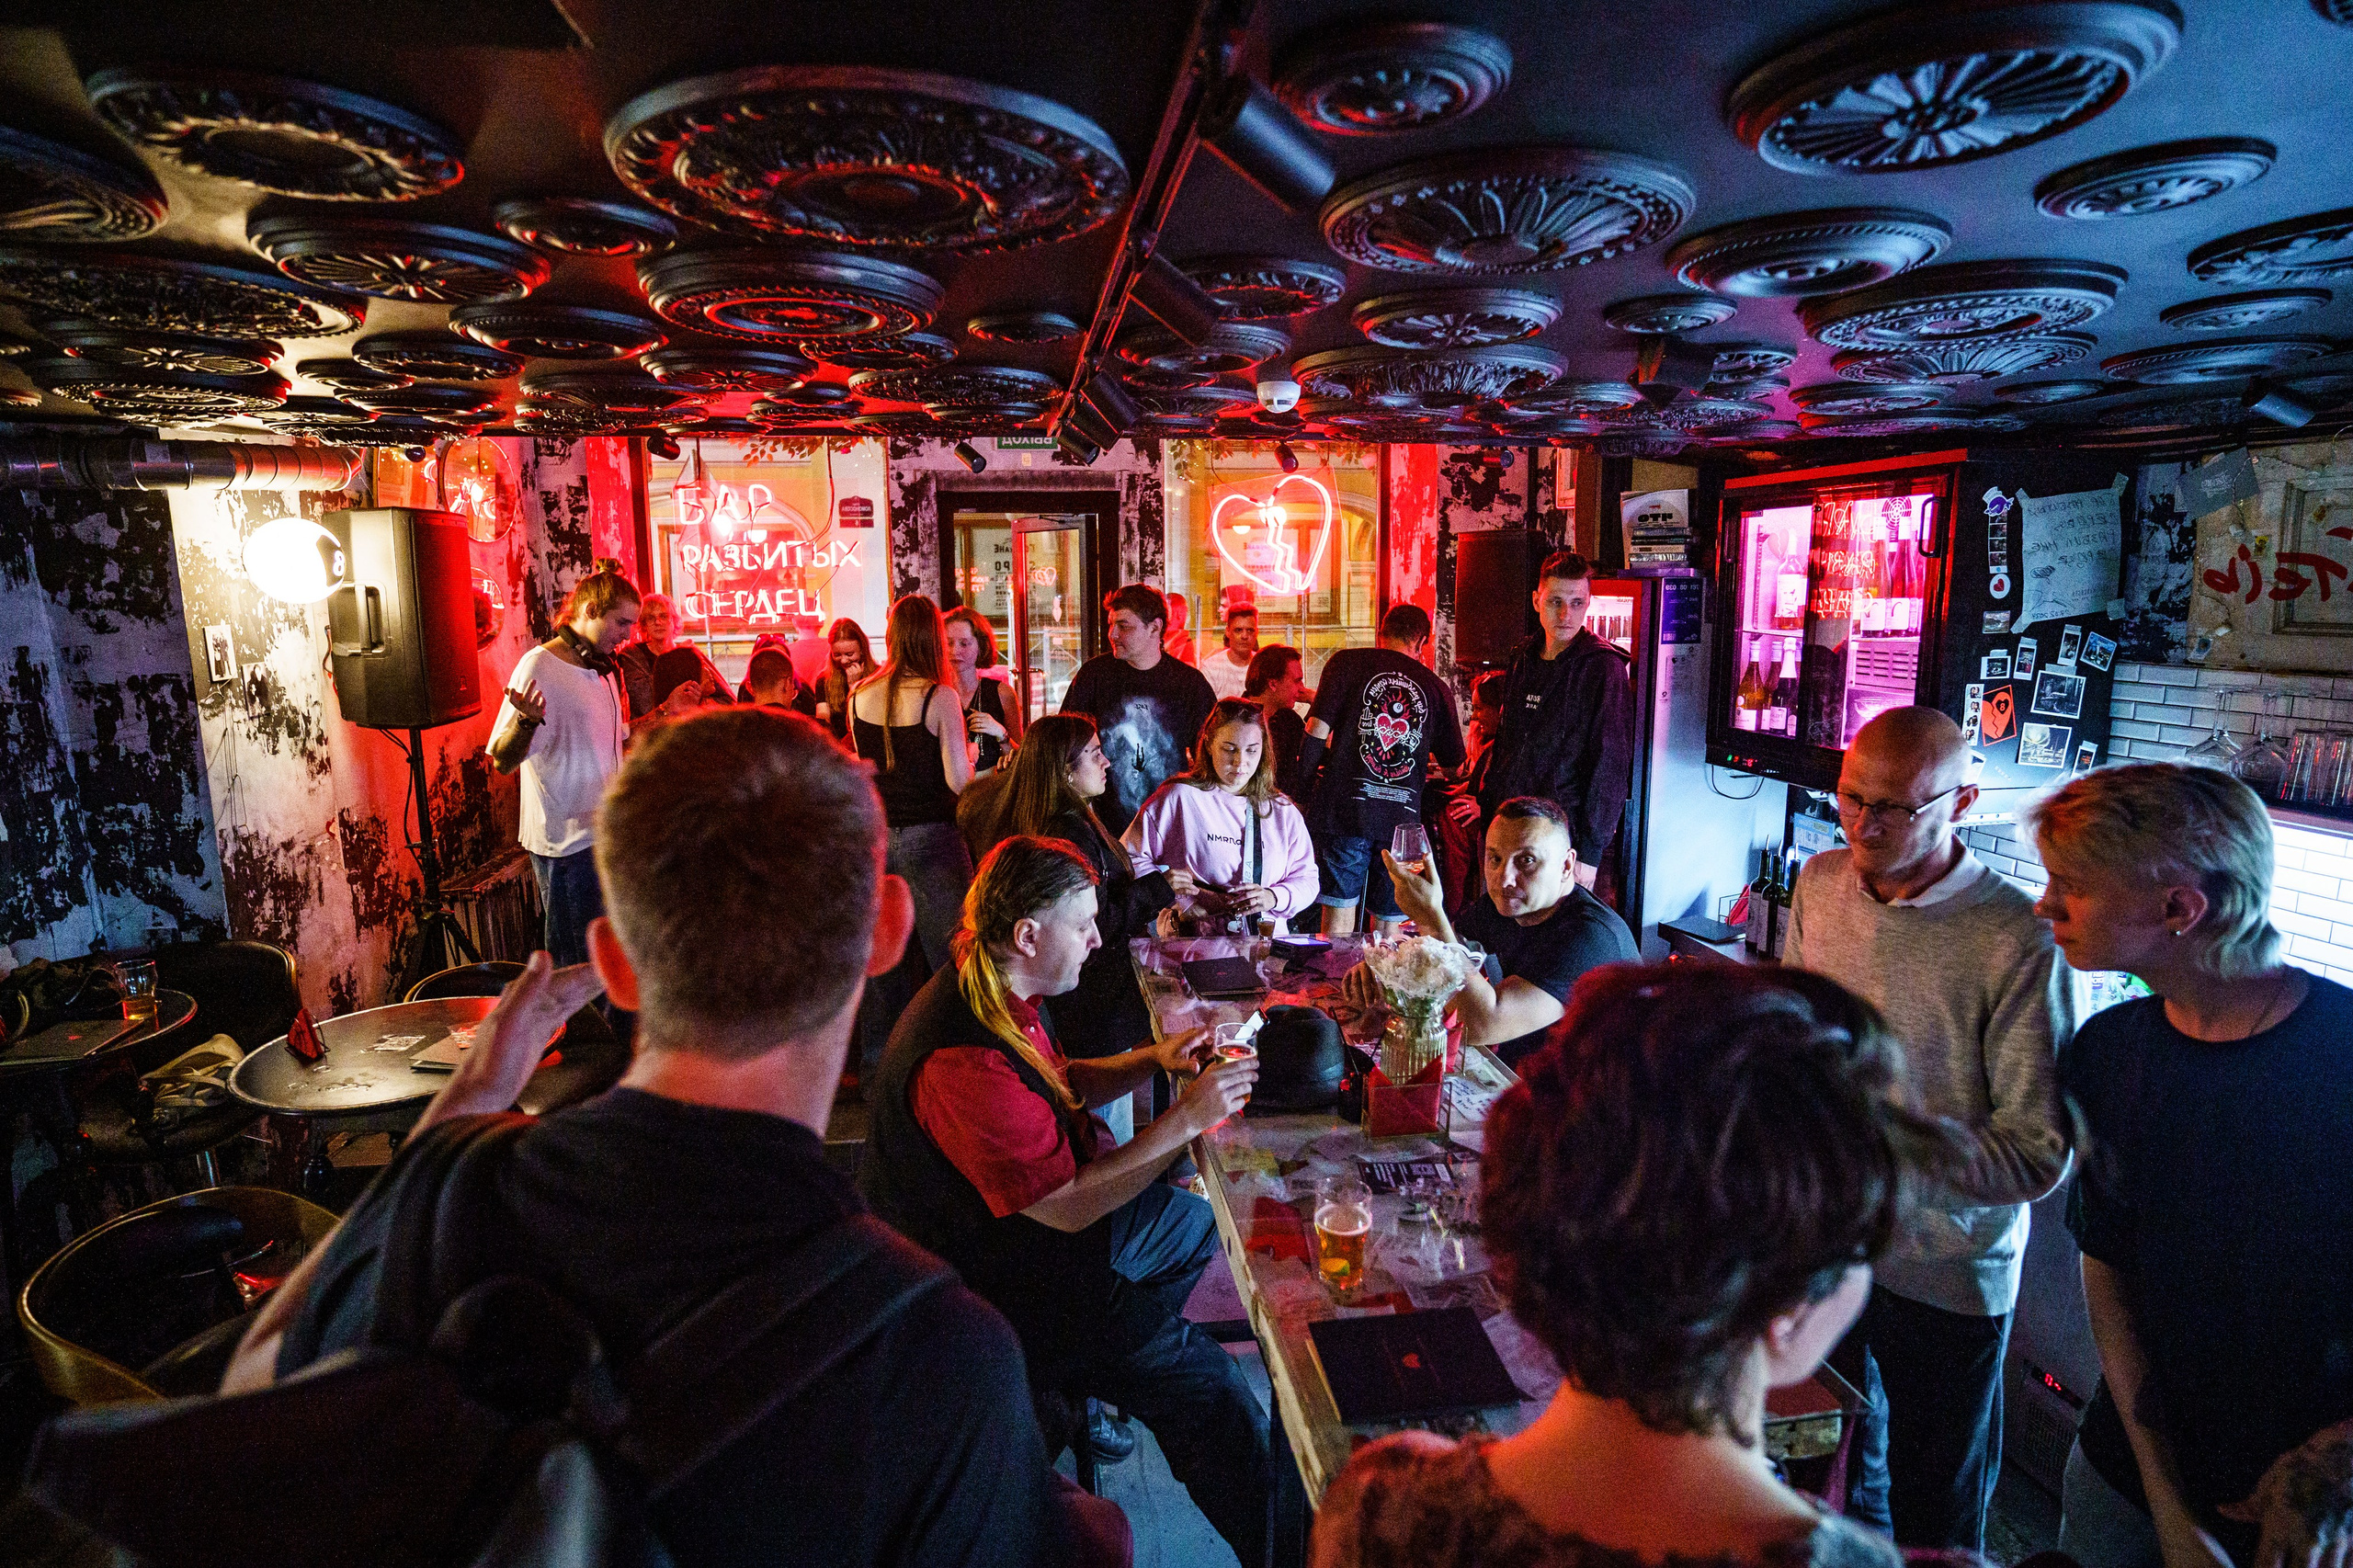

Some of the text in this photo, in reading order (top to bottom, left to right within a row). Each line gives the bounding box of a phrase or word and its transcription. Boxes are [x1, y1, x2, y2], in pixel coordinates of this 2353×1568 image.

[676, 483, 773, 526] БАР
[333, 550, 345, 576] 8
[681, 540, 862, 573] РАЗБИТЫХ
[684, 588, 826, 624] СЕРДЕЦ
[1999, 701, 2006, 711] 8
